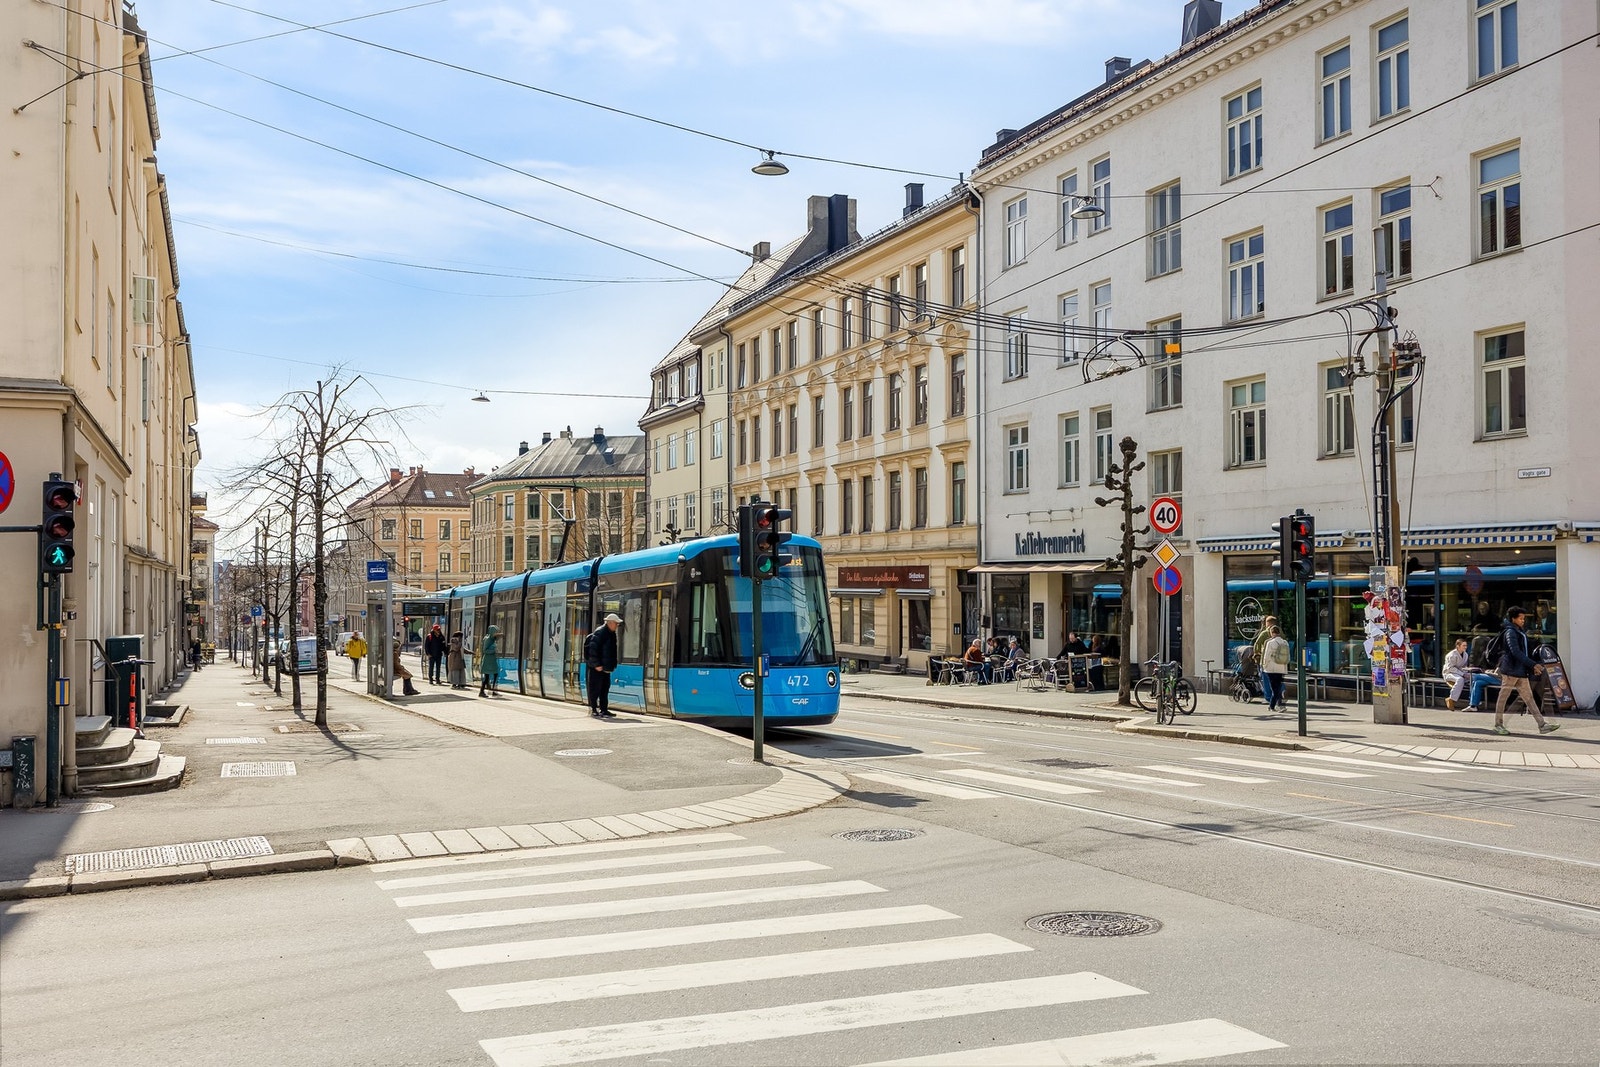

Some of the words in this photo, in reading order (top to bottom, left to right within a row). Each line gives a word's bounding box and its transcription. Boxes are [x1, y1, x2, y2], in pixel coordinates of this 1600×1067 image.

[1156, 507, 1176, 524] 40
[1015, 528, 1085, 555] Kaffebrenneriet
[1235, 614, 1265, 624] backstube
[787, 675, 810, 686] 472
